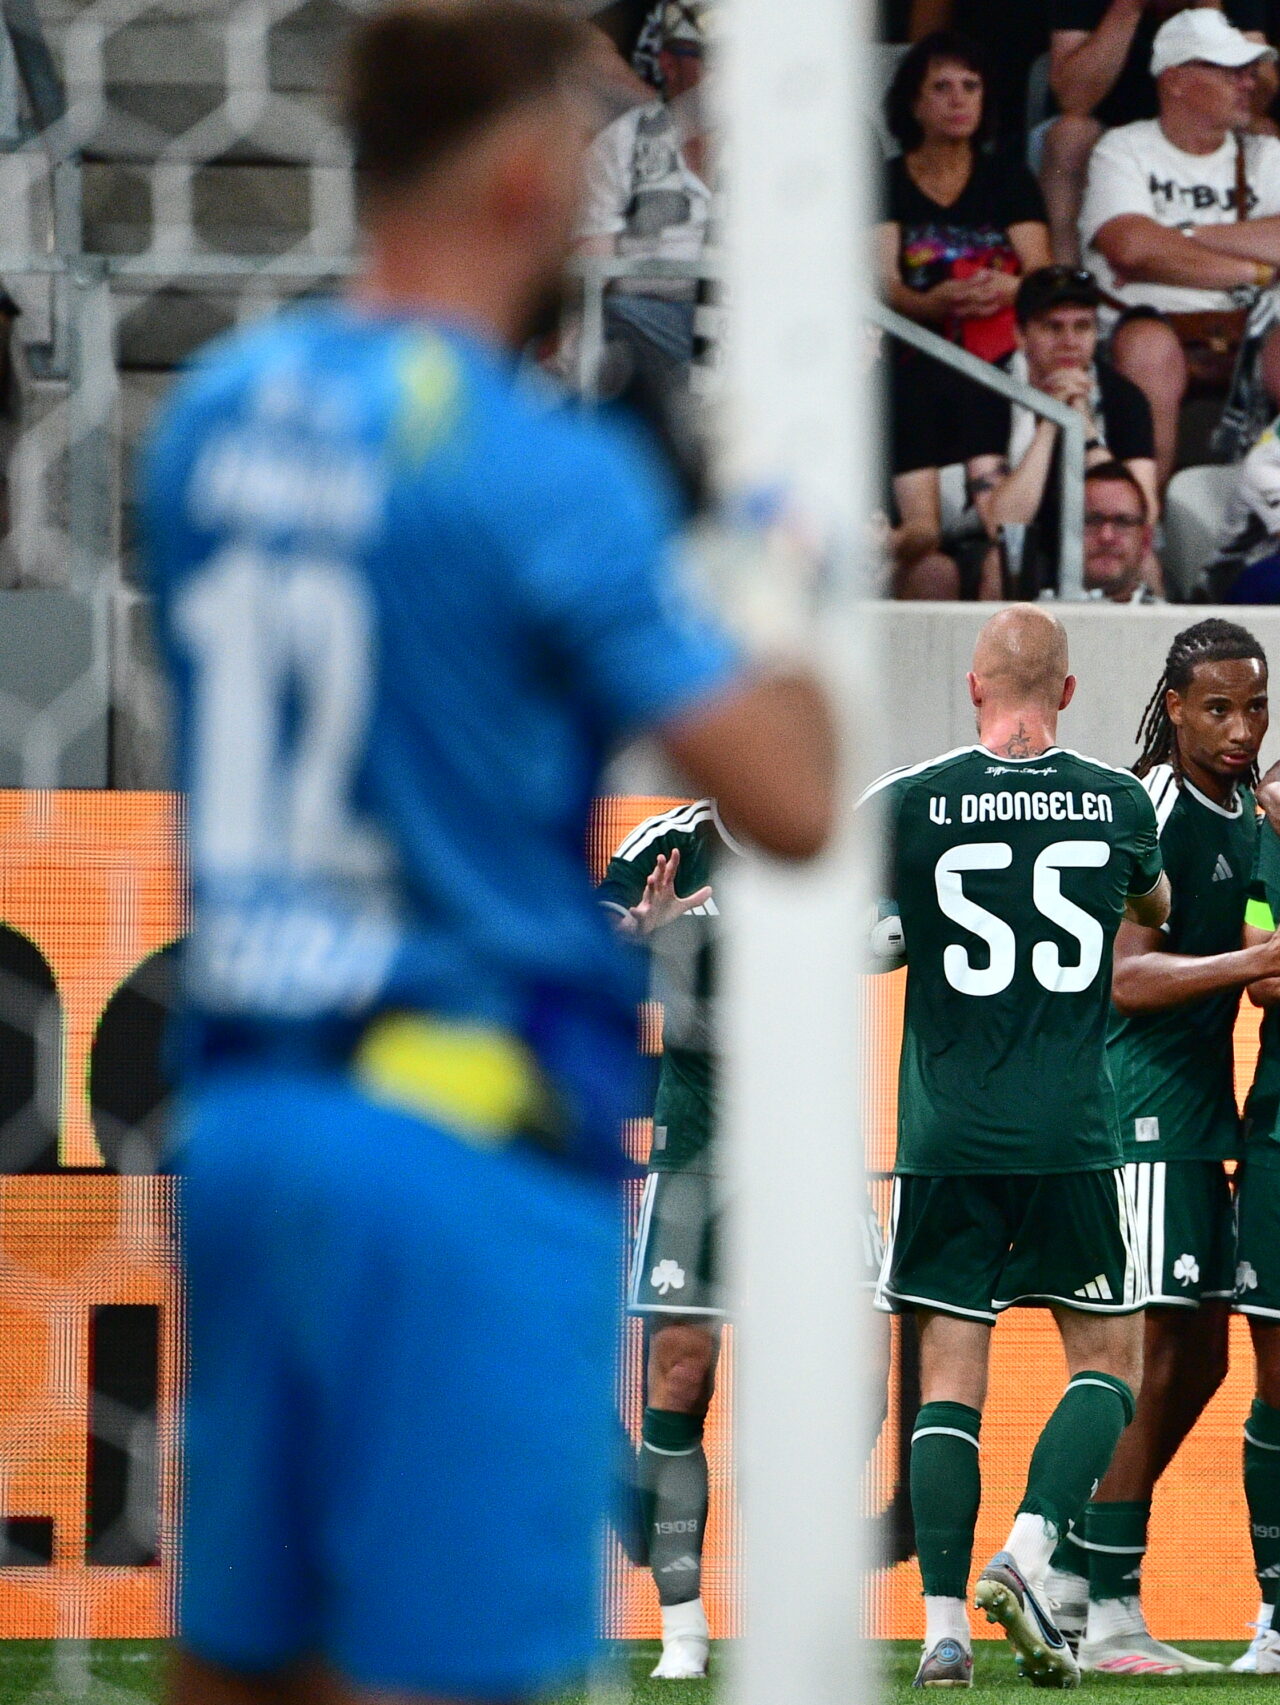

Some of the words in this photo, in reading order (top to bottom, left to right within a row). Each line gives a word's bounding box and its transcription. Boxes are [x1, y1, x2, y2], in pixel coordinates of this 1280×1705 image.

[961, 791, 1113, 823] DRONGELEN
[934, 840, 1111, 996] 55
[653, 1519, 698, 1535] 1908
